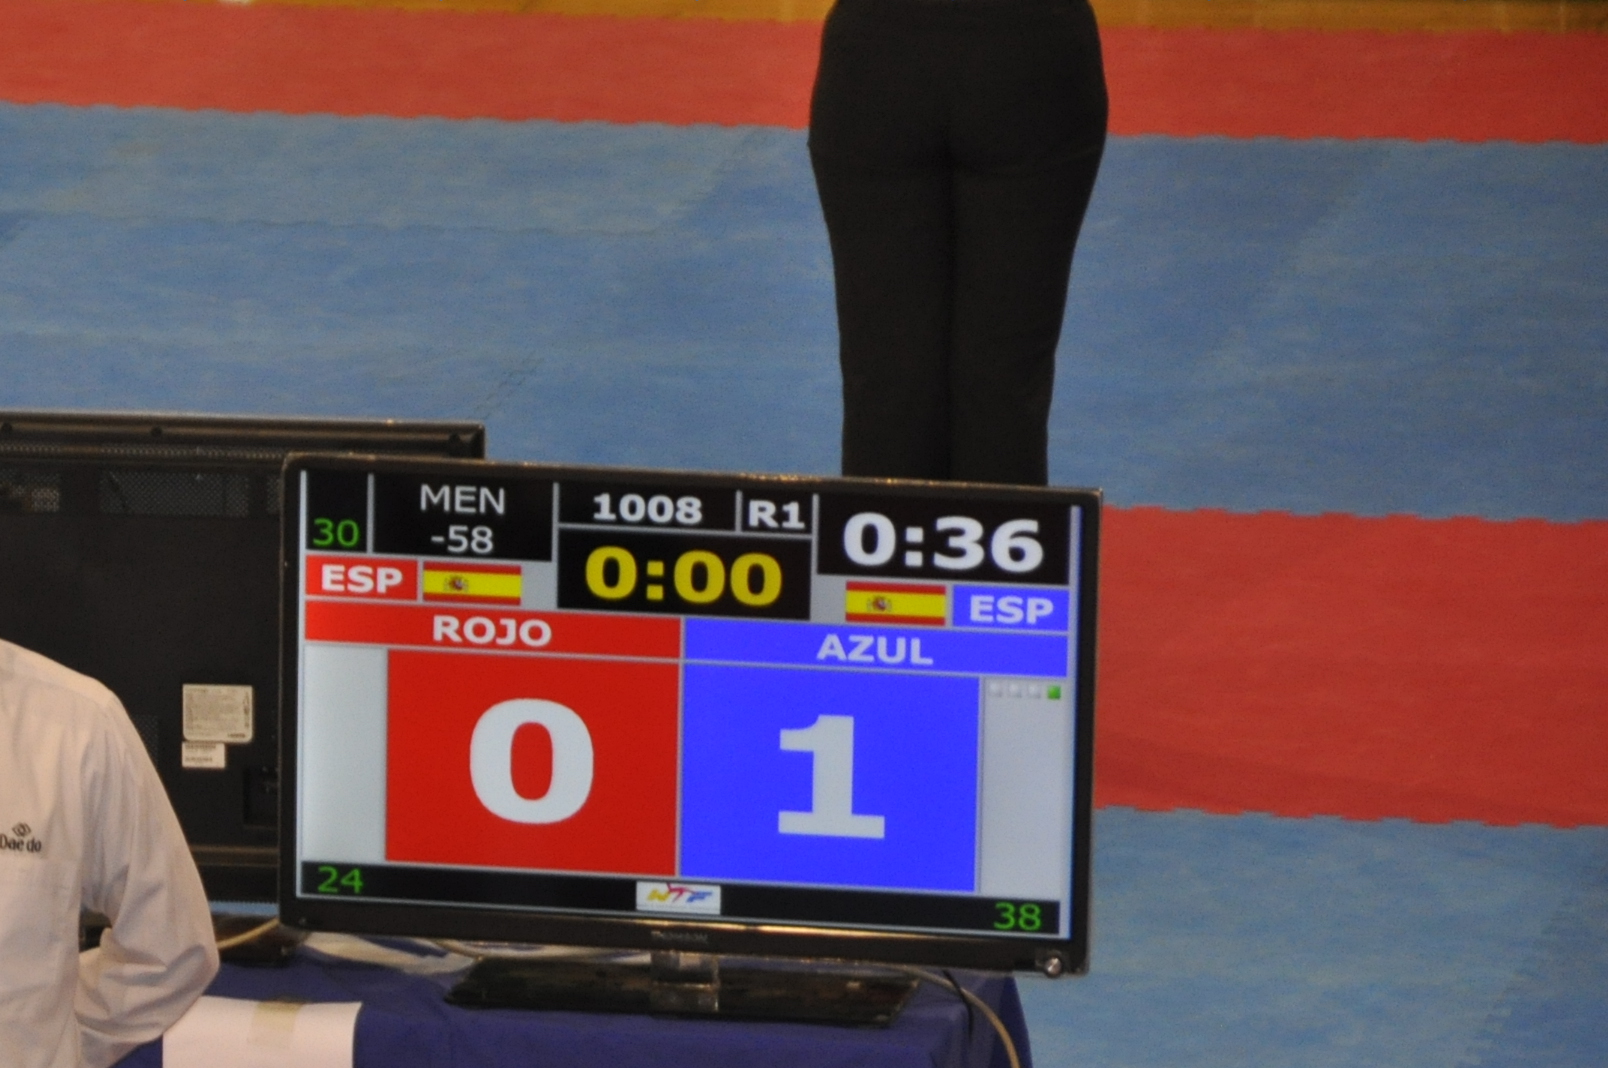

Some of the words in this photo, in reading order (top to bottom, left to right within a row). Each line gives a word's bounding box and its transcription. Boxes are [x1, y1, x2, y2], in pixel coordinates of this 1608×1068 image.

[419, 483, 506, 515] MEN
[593, 492, 703, 524] 1008
[748, 499, 805, 530] R1
[312, 518, 359, 547] 30
[430, 525, 494, 554] -58
[843, 511, 1044, 573] 0:36
[321, 564, 403, 594] ESP
[585, 546, 783, 607] 0:00
[969, 594, 1055, 625] ESP
[433, 614, 553, 647] ROJO
[816, 633, 934, 666] AZUL
[469, 697, 594, 824] 0
[778, 714, 885, 839] 1
[317, 865, 364, 894] 24
[993, 901, 1042, 932] 38
